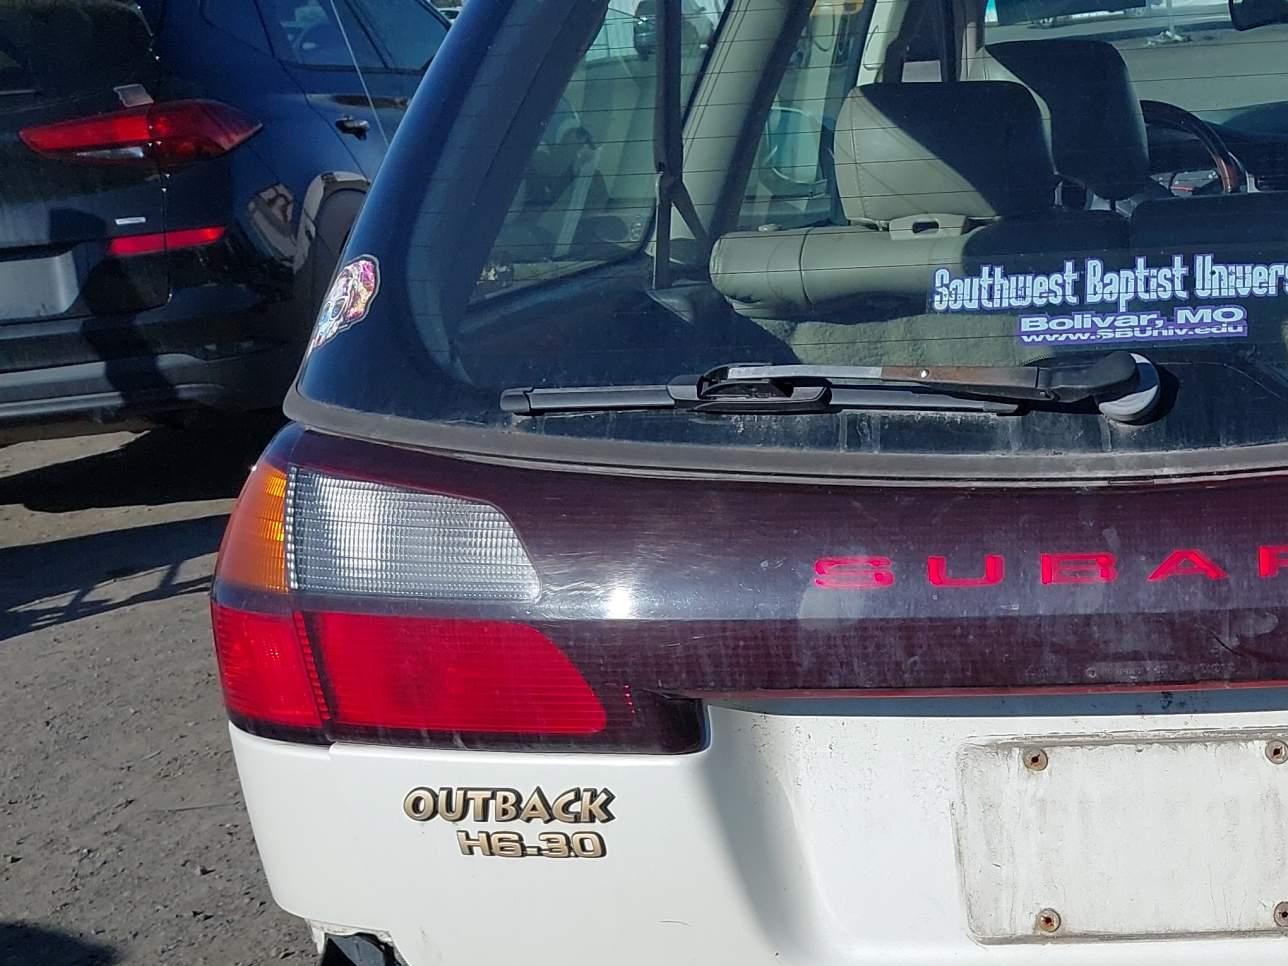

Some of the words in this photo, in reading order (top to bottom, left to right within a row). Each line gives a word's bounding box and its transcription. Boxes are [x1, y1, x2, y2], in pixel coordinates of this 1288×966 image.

[934, 260, 1078, 311] Southwest
[1087, 255, 1188, 312] Baptist
[1020, 313, 1164, 332] Bolivar,
[1177, 307, 1244, 325] MO
[403, 786, 616, 824] OUTBACK
